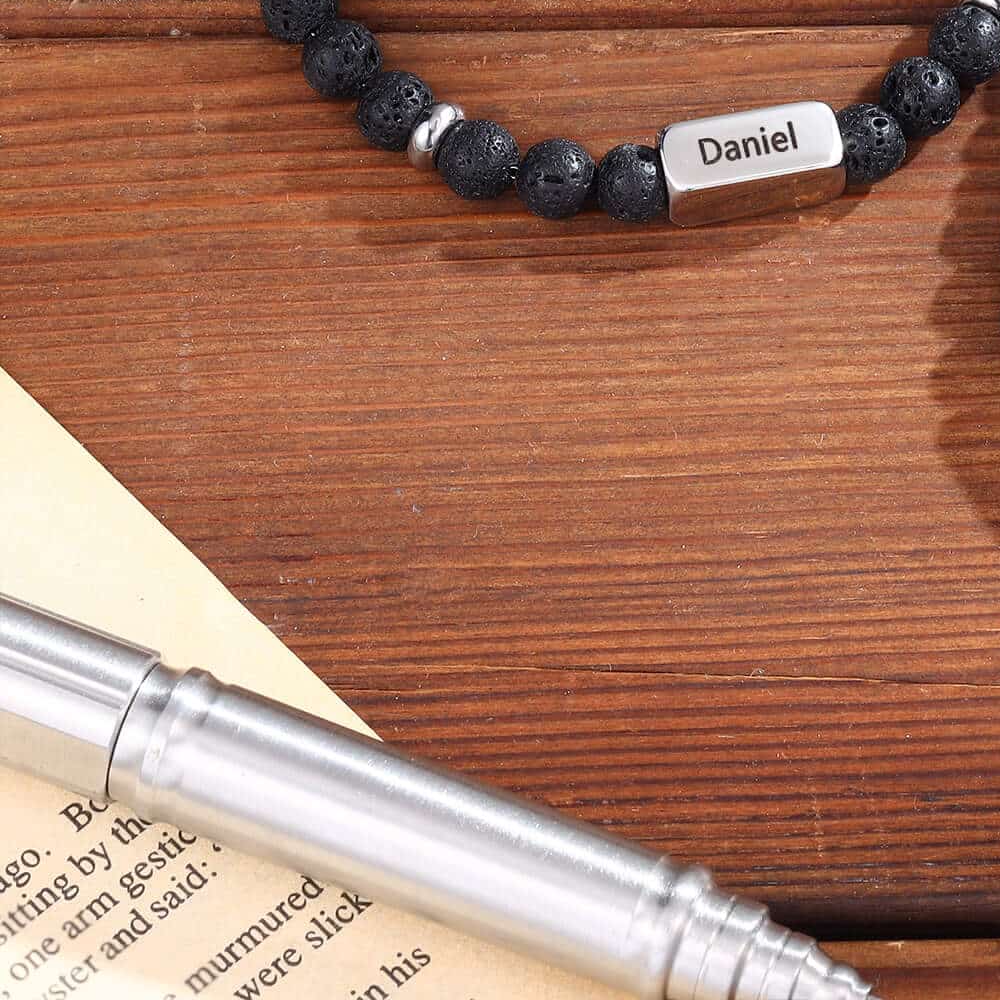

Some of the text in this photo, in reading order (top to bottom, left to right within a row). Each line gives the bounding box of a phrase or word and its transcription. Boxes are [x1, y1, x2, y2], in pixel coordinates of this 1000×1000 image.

[698, 121, 798, 165] Daniel
[67, 841, 112, 876] by
[111, 817, 152, 845] th
[9, 937, 61, 981] one
[62, 891, 120, 940] arm
[99, 908, 153, 961] and
[150, 863, 217, 920] said:
[184, 874, 325, 994] murmured
[233, 891, 374, 1000] were slick
[380, 947, 431, 988] his
